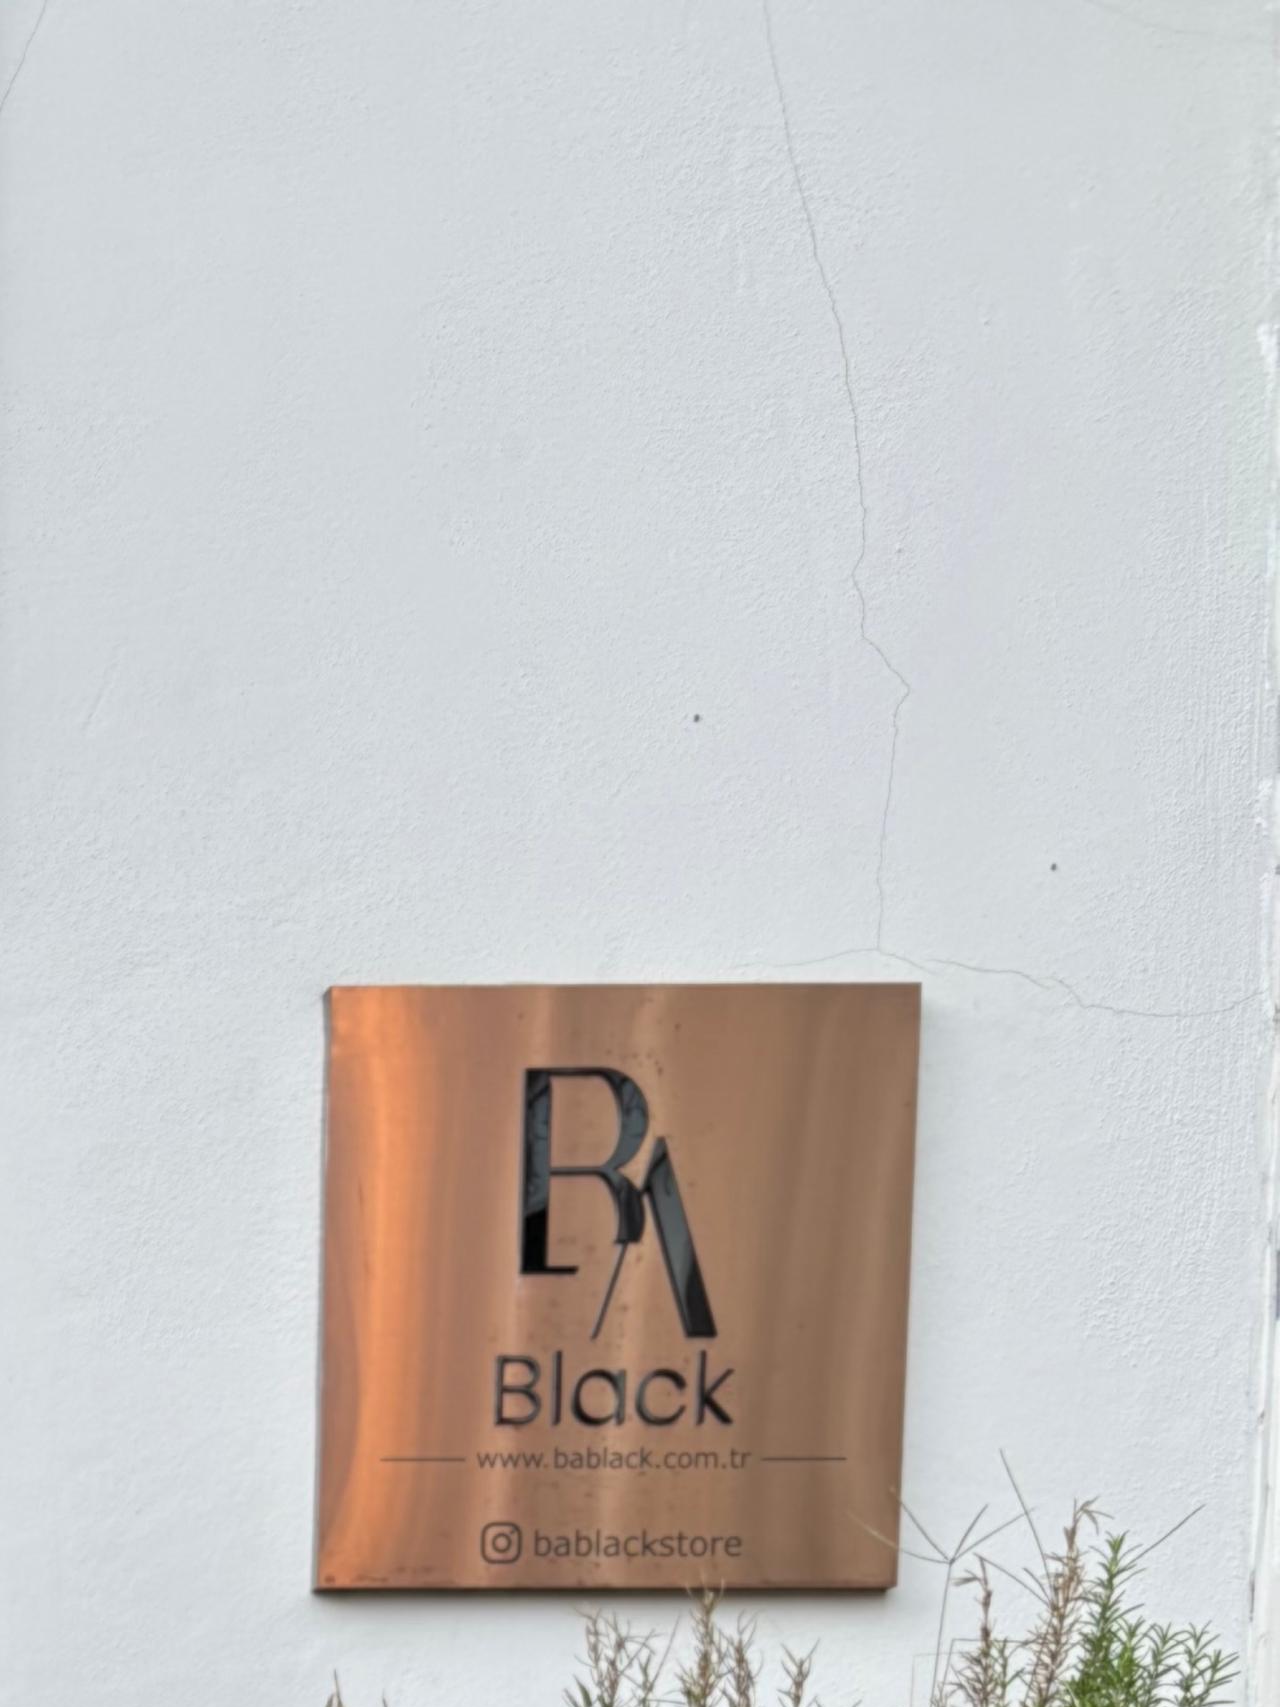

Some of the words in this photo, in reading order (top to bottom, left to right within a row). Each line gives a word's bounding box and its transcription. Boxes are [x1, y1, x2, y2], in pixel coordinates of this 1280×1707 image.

[493, 1350, 736, 1428] Black
[476, 1447, 752, 1471] www.bablack.com.tr
[533, 1528, 743, 1559] bablackstore
